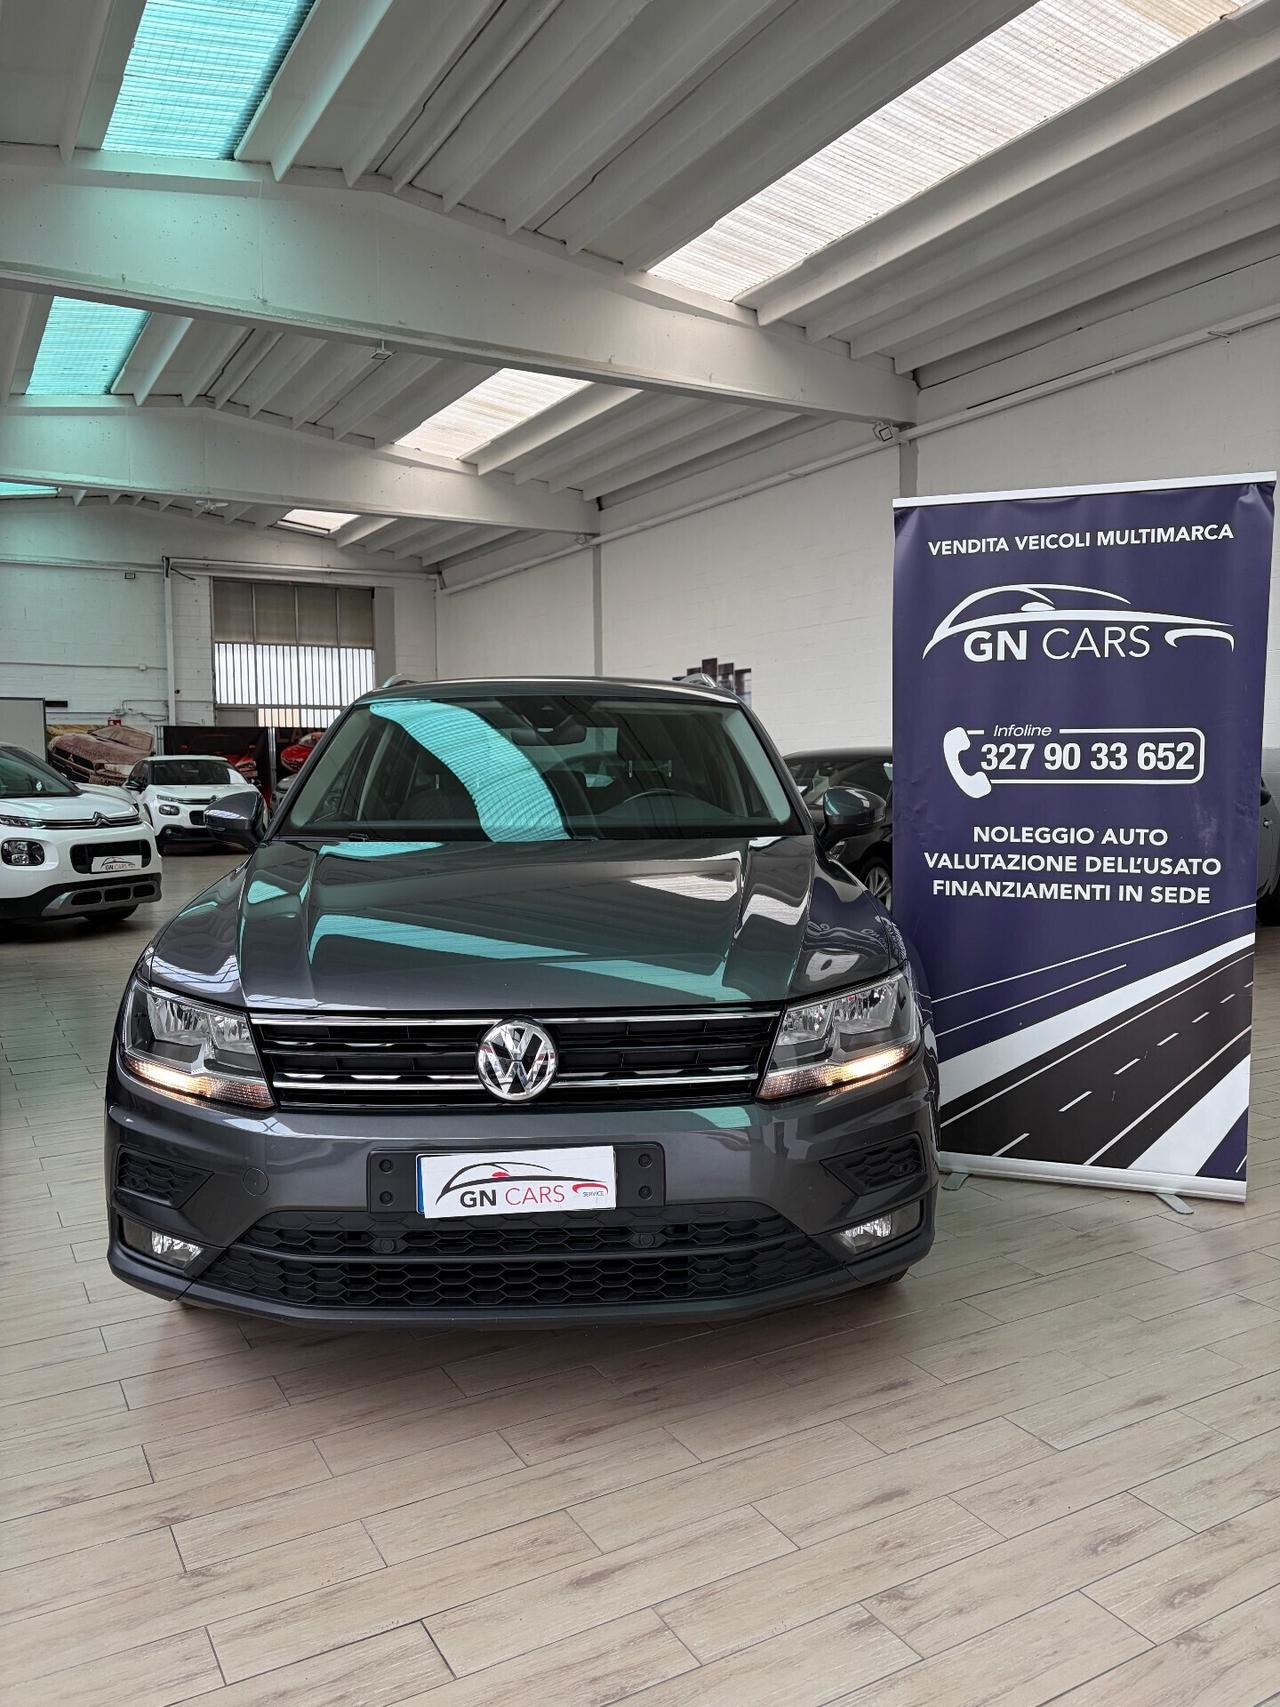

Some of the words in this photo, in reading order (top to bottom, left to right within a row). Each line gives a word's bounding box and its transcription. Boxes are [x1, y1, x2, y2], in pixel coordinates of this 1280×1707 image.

[928, 536, 1010, 556] VENDITA
[1014, 532, 1091, 551] VEICOLI
[1097, 524, 1234, 547] MULTIMARCA
[963, 629, 1028, 663] GN
[1041, 624, 1151, 660] CARS
[993, 724, 1052, 737] Infoline
[980, 742, 1035, 771] 327
[1043, 742, 1081, 771] 90
[1090, 742, 1128, 771] 33
[1137, 741, 1195, 771] 652
[973, 826, 1095, 845] NOLEGGIO
[1101, 828, 1169, 846] AUTO
[924, 852, 1078, 872] VALUTAZIONE
[932, 879, 1111, 901] FINANZIAMENTI
[1118, 885, 1143, 902] IN
[1150, 885, 1211, 904] SEDE
[459, 1189, 497, 1208] GN
[504, 1184, 565, 1206] CARS
[582, 1190, 604, 1198] SERVICE
